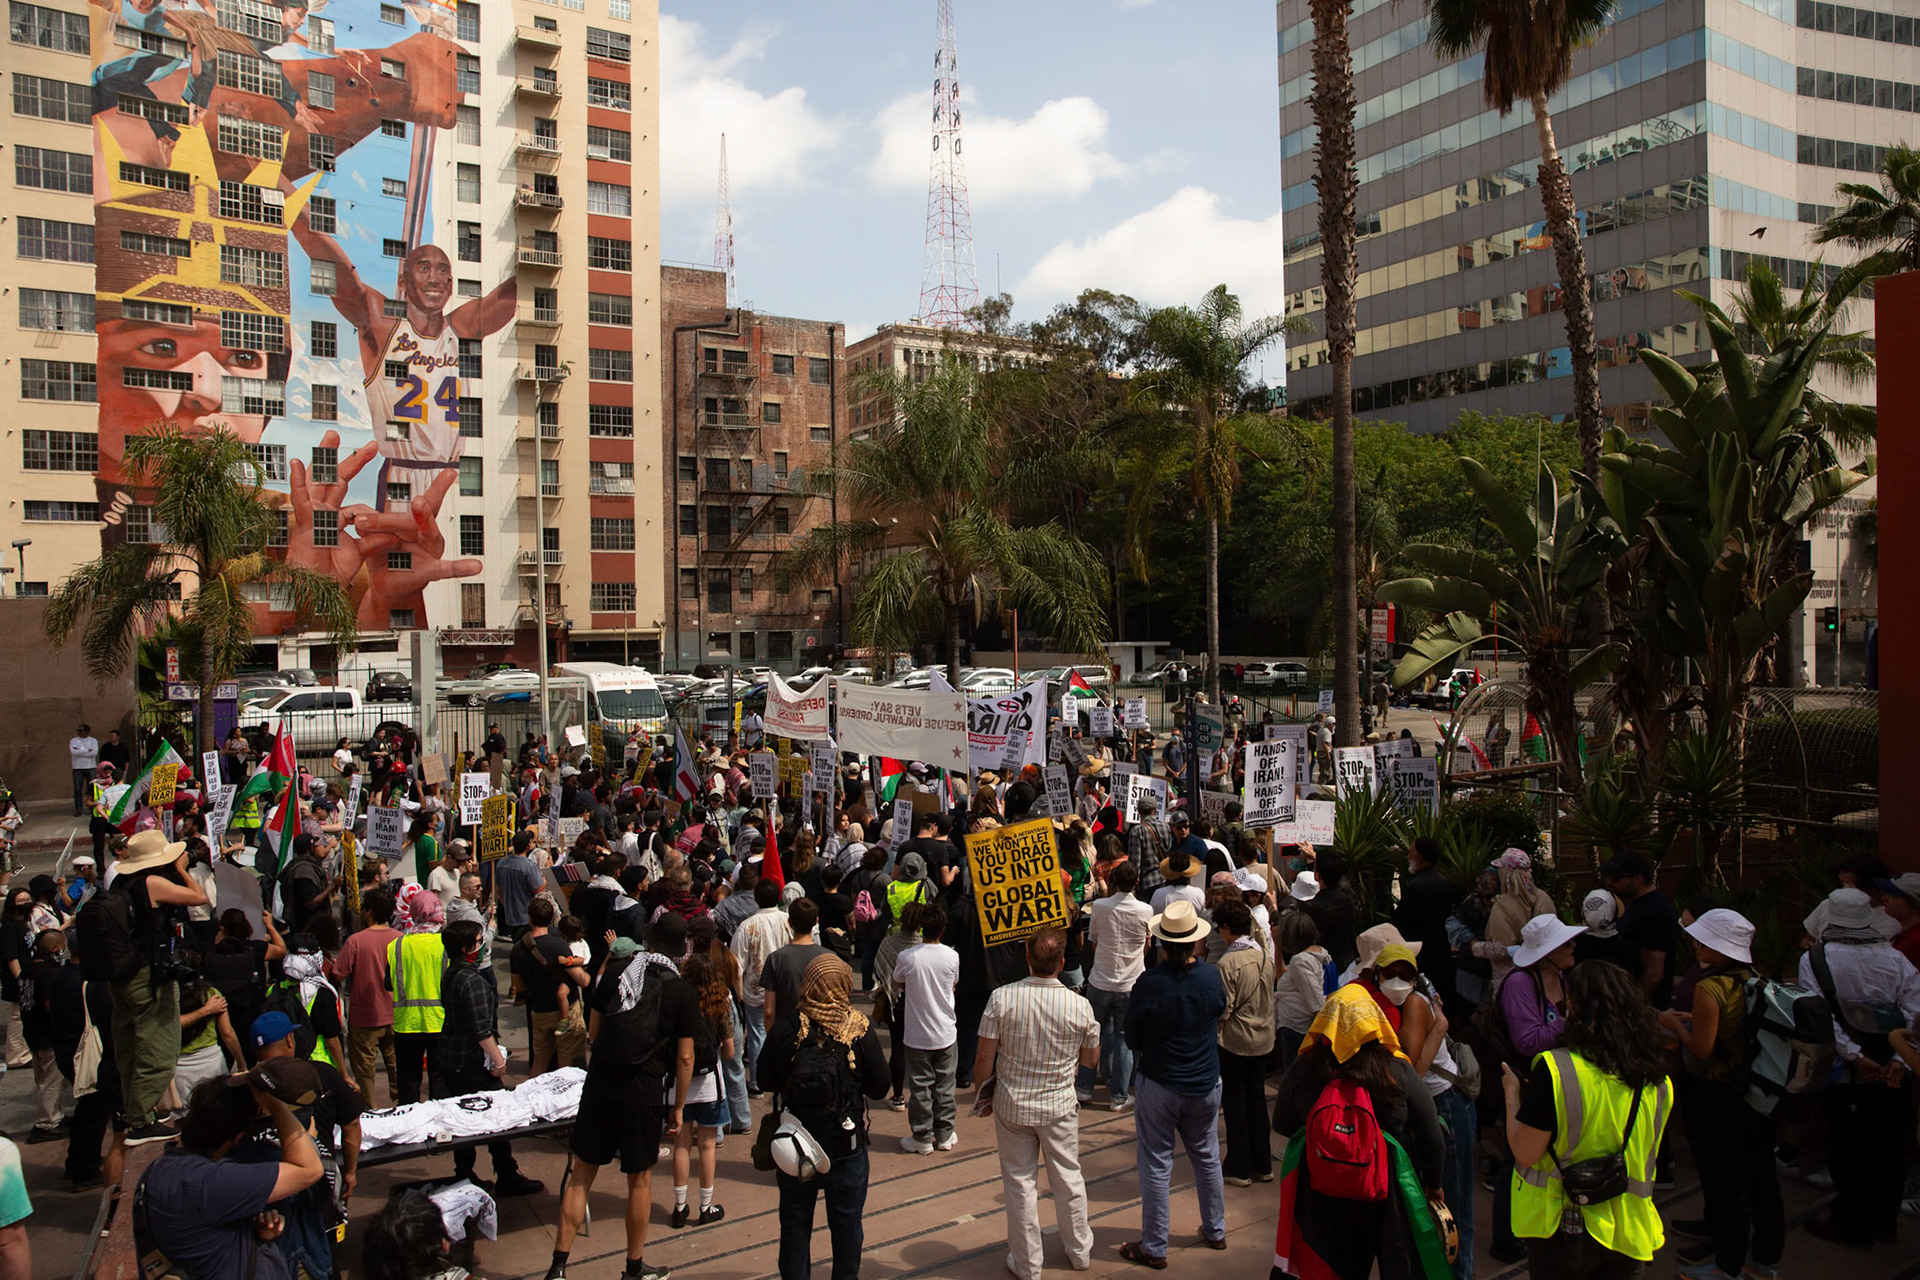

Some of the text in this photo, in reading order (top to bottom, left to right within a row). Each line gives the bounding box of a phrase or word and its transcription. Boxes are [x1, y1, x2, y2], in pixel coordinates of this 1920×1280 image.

[392, 332, 419, 353] Los
[404, 350, 460, 374] Angeles
[393, 373, 462, 429] 24
[168, 655, 178, 683] ATM
[1253, 741, 1287, 757] HANDS
[751, 763, 765, 775] STOP
[1259, 756, 1278, 769] OFF
[1339, 760, 1364, 778] STOP
[1112, 773, 1130, 787] STOP
[1253, 766, 1284, 784] IRAN!
[1394, 772, 1434, 788] STOP the
[1047, 777, 1062, 791] STOP
[1254, 784, 1283, 798] HANDS
[151, 789, 174, 801] WAR!
[463, 785, 483, 799] STOP
[1258, 796, 1277, 809] OFF
[374, 807, 399, 817] HANDS
[1245, 805, 1292, 820] IMMIGRANTS!
[375, 822, 398, 833] IRAN!
[379, 816, 392, 824] OFF
[375, 833, 397, 841] HANDS
[973, 831, 1049, 857] WE WON'T LET
[1278, 834, 1289, 842] out
[1299, 833, 1321, 843] Middle
[1322, 834, 1333, 844] East
[483, 837, 505, 854] WAR!
[975, 842, 1051, 869] YOU DRAG
[978, 855, 1055, 887] US INTO
[982, 878, 1058, 909] GLOBAL
[984, 894, 1063, 932] WAR!
